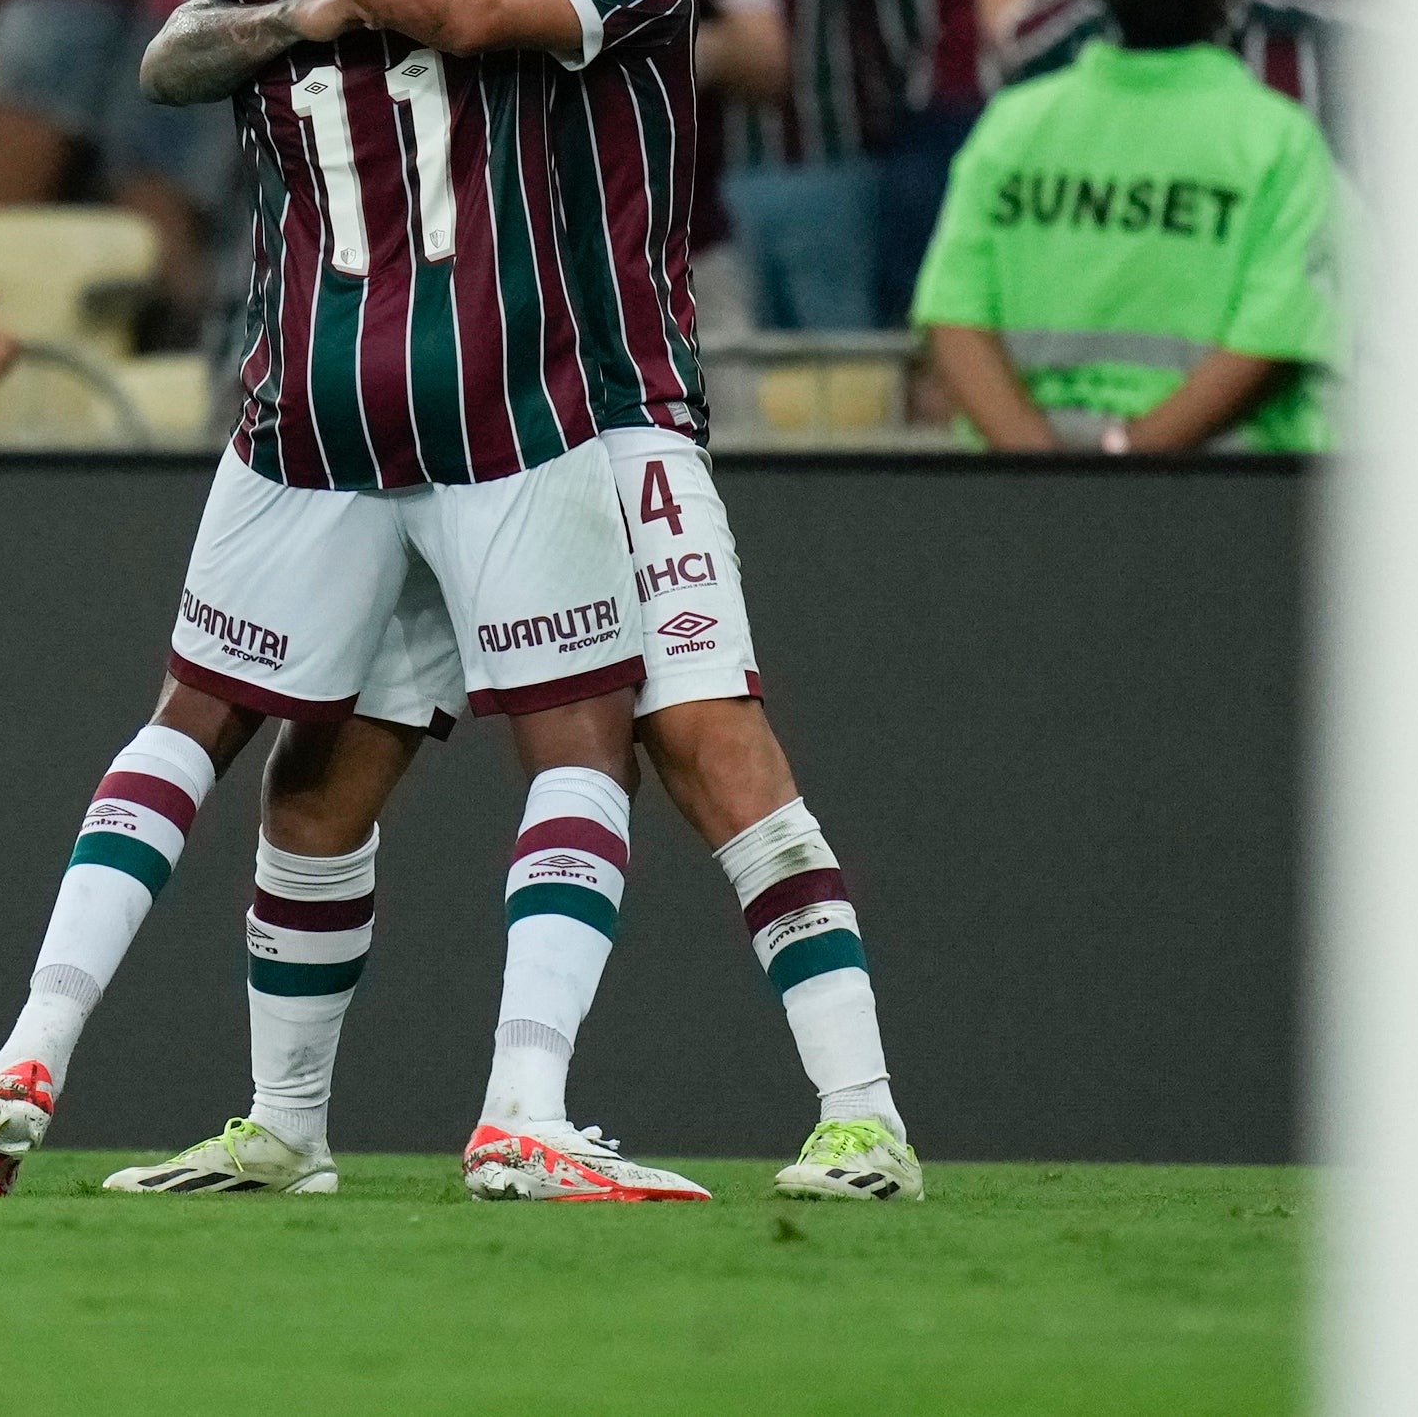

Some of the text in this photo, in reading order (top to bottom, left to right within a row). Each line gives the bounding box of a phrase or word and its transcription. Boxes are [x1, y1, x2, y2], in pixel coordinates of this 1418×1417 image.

[290, 48, 458, 276] 11
[990, 173, 1239, 242] SUNSET
[623, 461, 683, 547] 4
[558, 627, 622, 654] RECOVERY
[666, 639, 716, 656] umbro
[221, 644, 283, 671] RECOVERY
[528, 869, 598, 884] umbro
